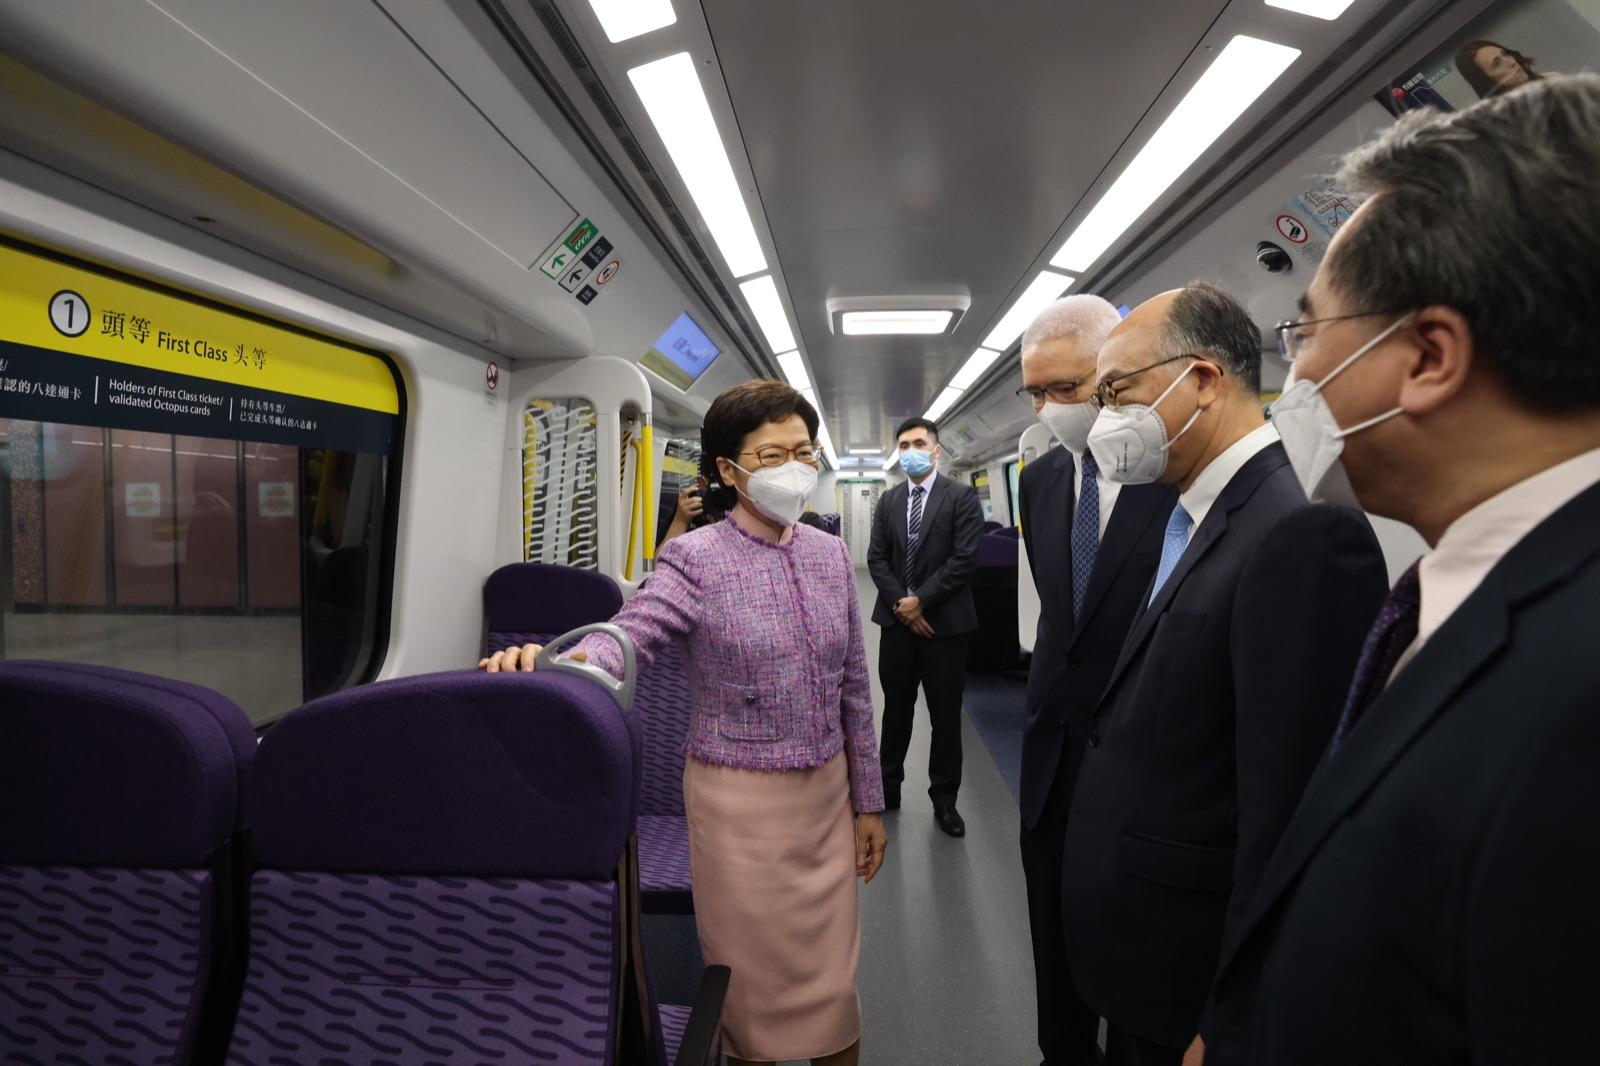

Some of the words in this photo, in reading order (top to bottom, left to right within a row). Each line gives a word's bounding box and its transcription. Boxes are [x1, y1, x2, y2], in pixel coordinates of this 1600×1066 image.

[64, 299, 74, 329] 1
[101, 309, 150, 344] 頭等
[157, 331, 190, 354] First
[193, 340, 228, 362] Class
[233, 343, 266, 370] 头等
[0, 377, 81, 400] 認的八達通卡
[109, 379, 146, 394] Holders
[147, 385, 158, 396] of
[158, 387, 176, 399] First
[177, 390, 198, 402] Class
[199, 393, 224, 406] ticket/
[109, 394, 152, 409] validated
[153, 399, 189, 414] Octopus
[190, 405, 211, 416] cards
